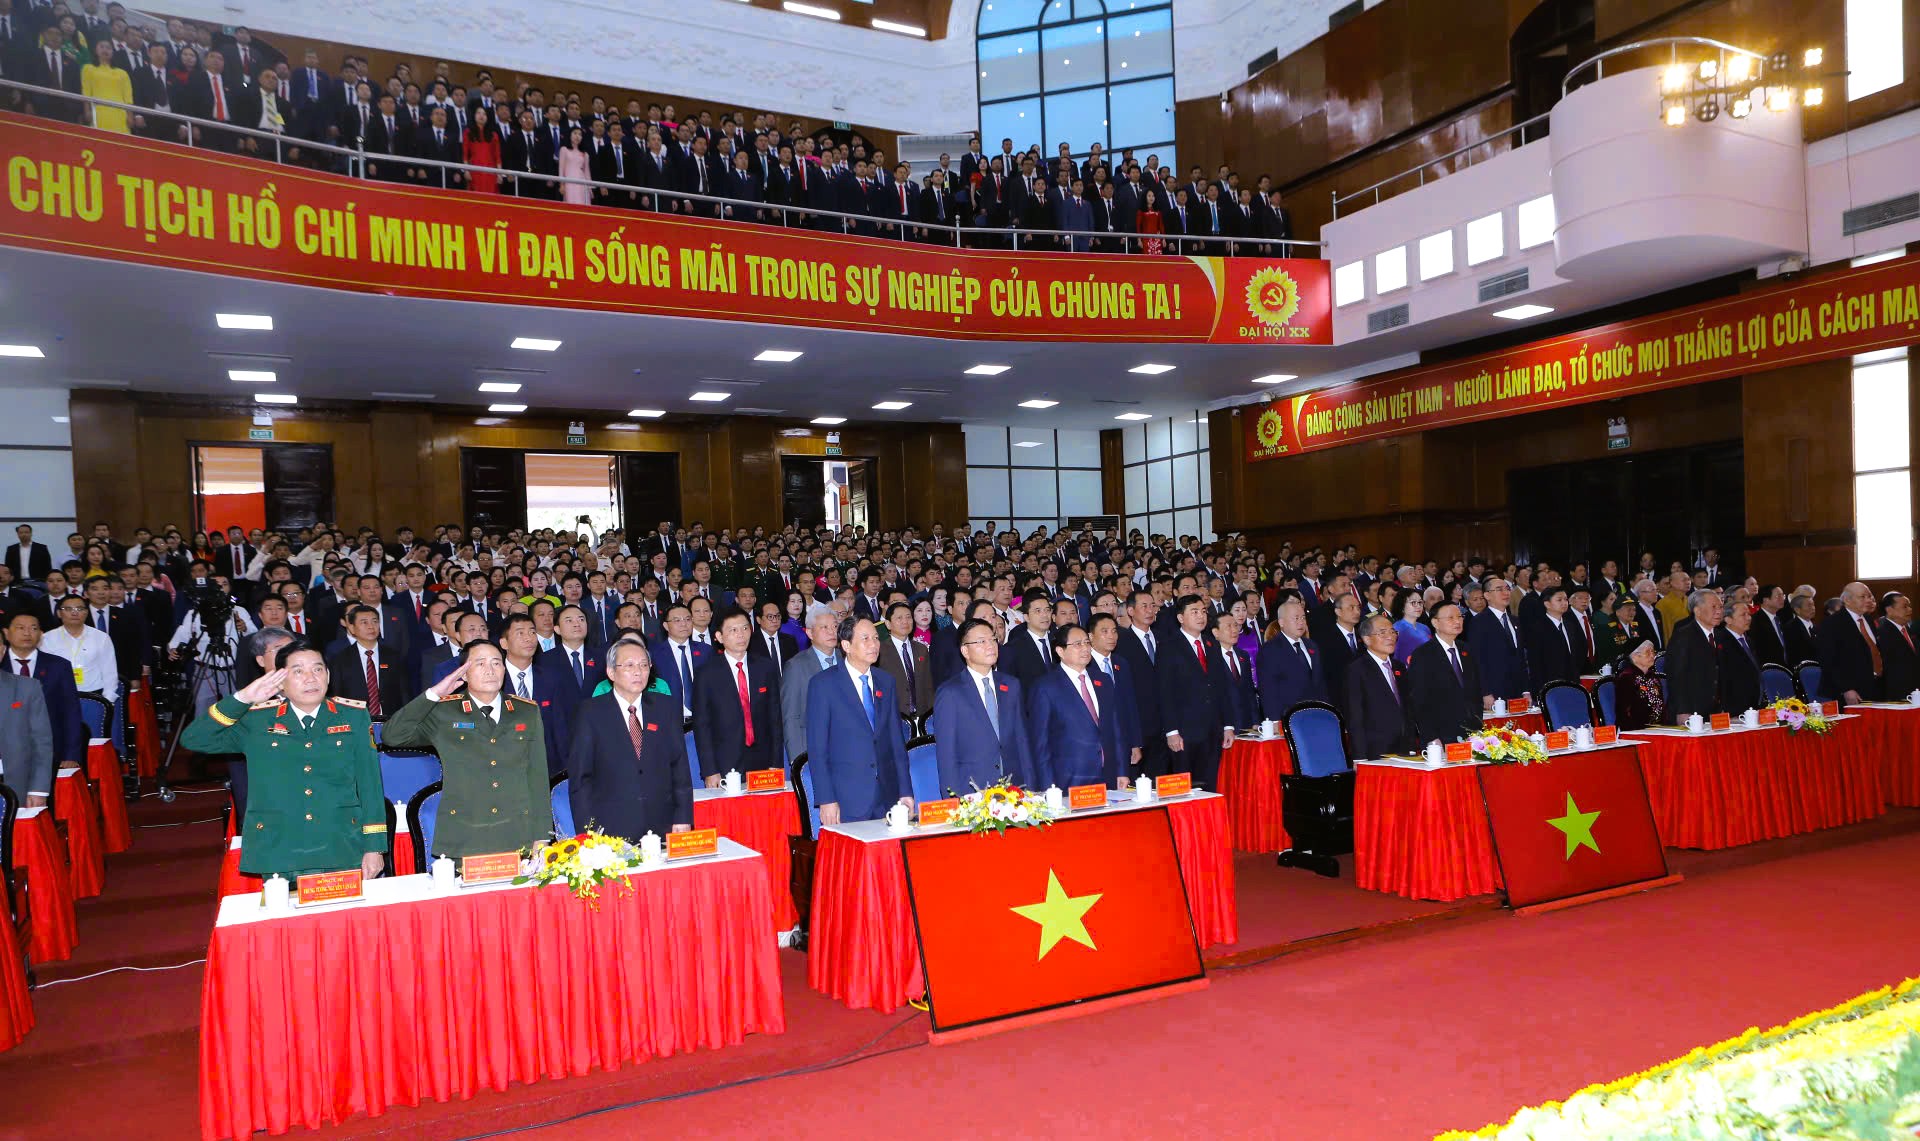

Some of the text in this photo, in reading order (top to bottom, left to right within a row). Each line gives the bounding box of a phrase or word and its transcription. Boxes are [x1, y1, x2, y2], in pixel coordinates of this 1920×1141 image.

[8, 149, 103, 222] CHỦ
[117, 174, 215, 243] TỊCH
[228, 183, 281, 249] HỒ
[294, 202, 357, 259] CHÍ
[369, 215, 465, 270] MINH
[476, 221, 508, 274] VĨ
[519, 232, 574, 288] ĐẠI
[585, 226, 671, 288] SỐNG
[680, 243, 737, 293] MÃI
[745, 255, 837, 302] TRONG
[846, 265, 882, 315] SỰ
[888, 268, 981, 322] NGHIỆP
[990, 267, 1042, 317] CỦA
[1050, 274, 1135, 319] CHÚNG
[1239, 323, 1310, 340] ĐẠI HỘI XX
[1306, 404, 1332, 437] ĐẢNG
[1335, 400, 1363, 434] CỘNG
[1366, 391, 1386, 424] SẢN
[1390, 388, 1412, 424] VIỆT
[1415, 384, 1442, 414] NAM
[1454, 370, 1492, 408] NGƯỜI
[1496, 361, 1529, 399] LÃNH
[1534, 362, 1566, 397] ĐẠO,
[1570, 344, 1588, 386] TỔ
[1592, 342, 1632, 381] CHỨC
[1638, 337, 1669, 377] MỌI
[1674, 317, 1732, 366] THẮNG
[1738, 314, 1767, 358] LỢI
[1773, 299, 1812, 346] CỦA
[1818, 292, 1874, 337] CÁCH
[1883, 285, 1920, 329] MẠ
